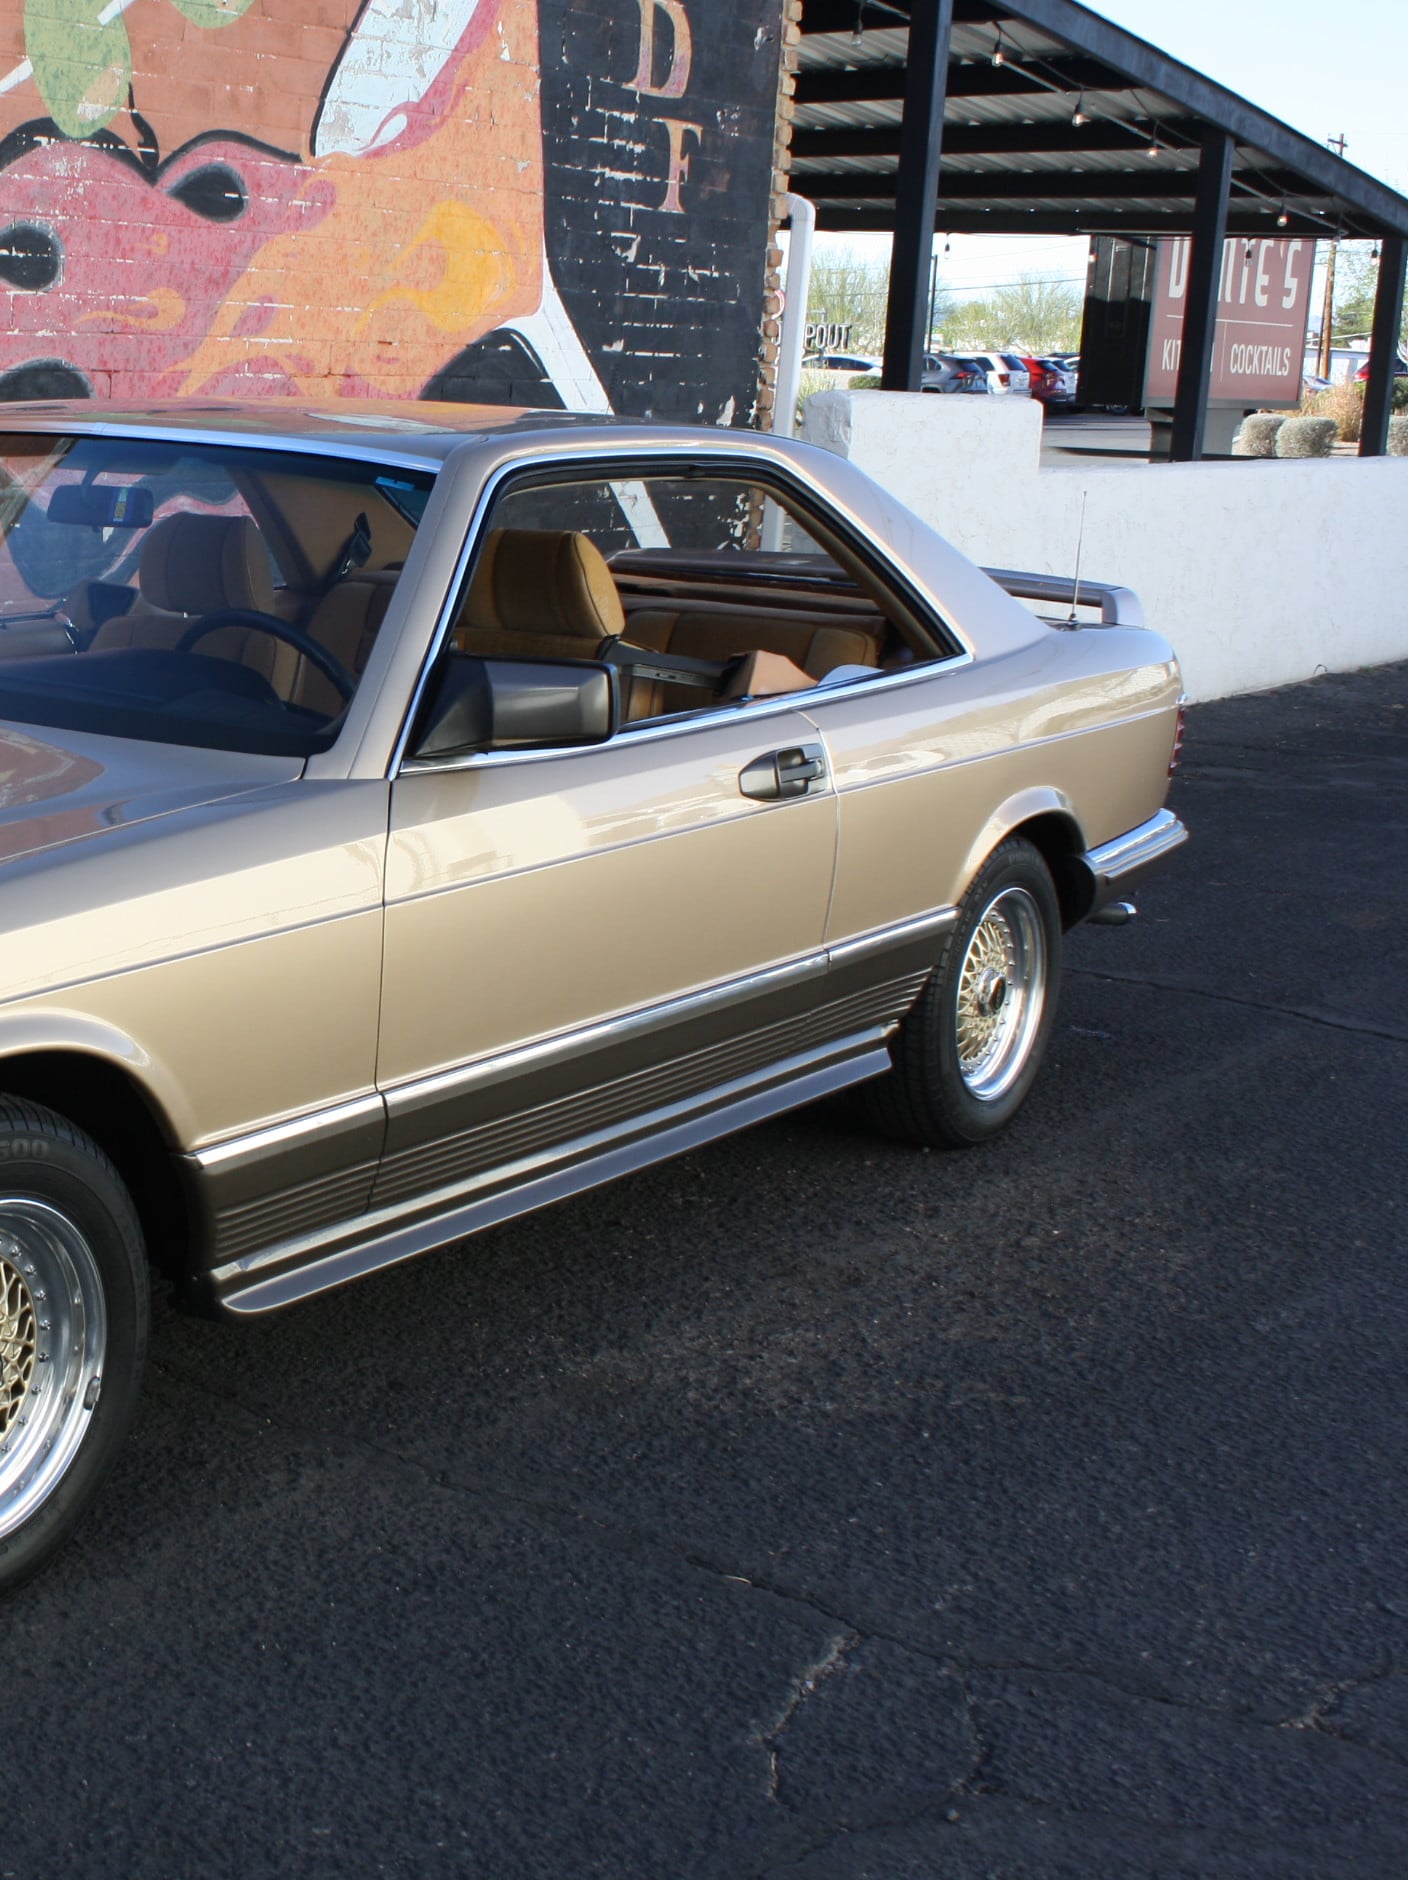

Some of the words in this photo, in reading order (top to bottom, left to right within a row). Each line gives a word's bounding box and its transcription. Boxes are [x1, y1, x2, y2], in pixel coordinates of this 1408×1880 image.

[656, 117, 704, 214] F
[1168, 237, 1302, 309] DNTE'S
[1230, 343, 1291, 377] COCKTAILS
